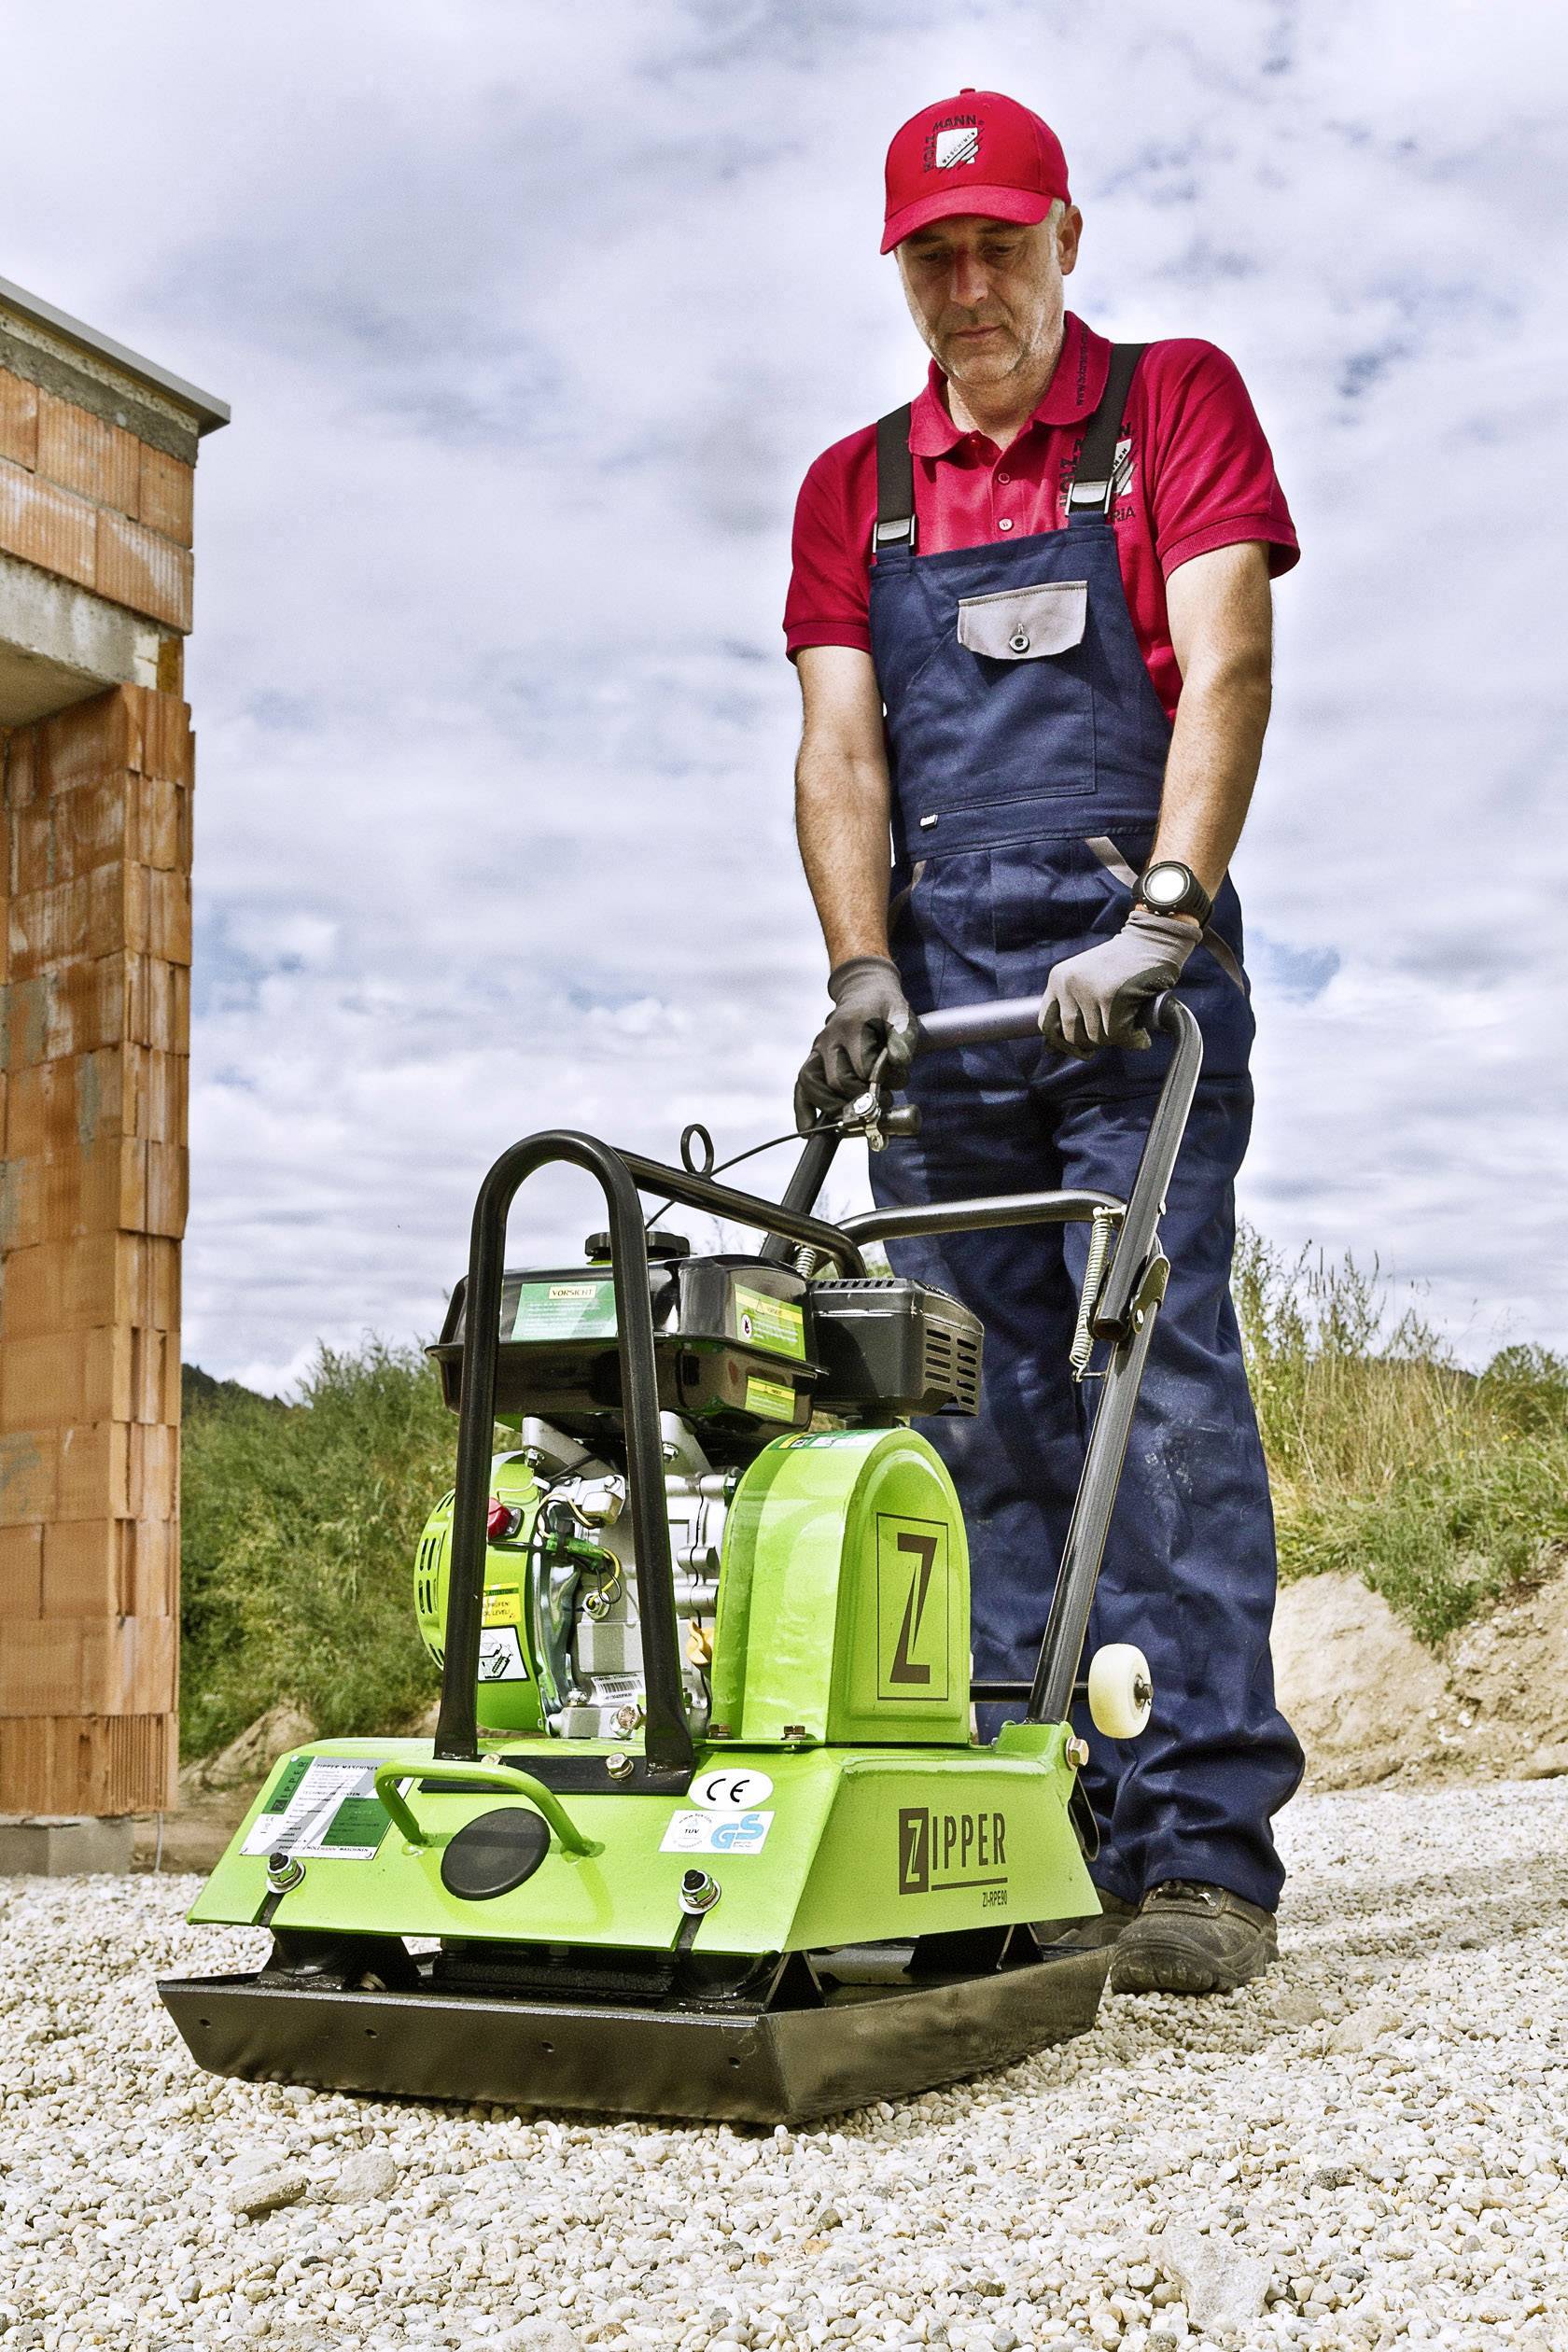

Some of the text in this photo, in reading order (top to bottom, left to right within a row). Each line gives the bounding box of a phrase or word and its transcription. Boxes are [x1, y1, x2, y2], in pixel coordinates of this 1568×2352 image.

[932, 115, 977, 131] MANN
[889, 1532, 938, 1685] Z
[707, 1777, 749, 1803] CE
[711, 1813, 764, 1849] GS
[902, 1810, 1006, 1887] ZIPPER
[982, 1889, 1008, 1908] ZI-RPE90
